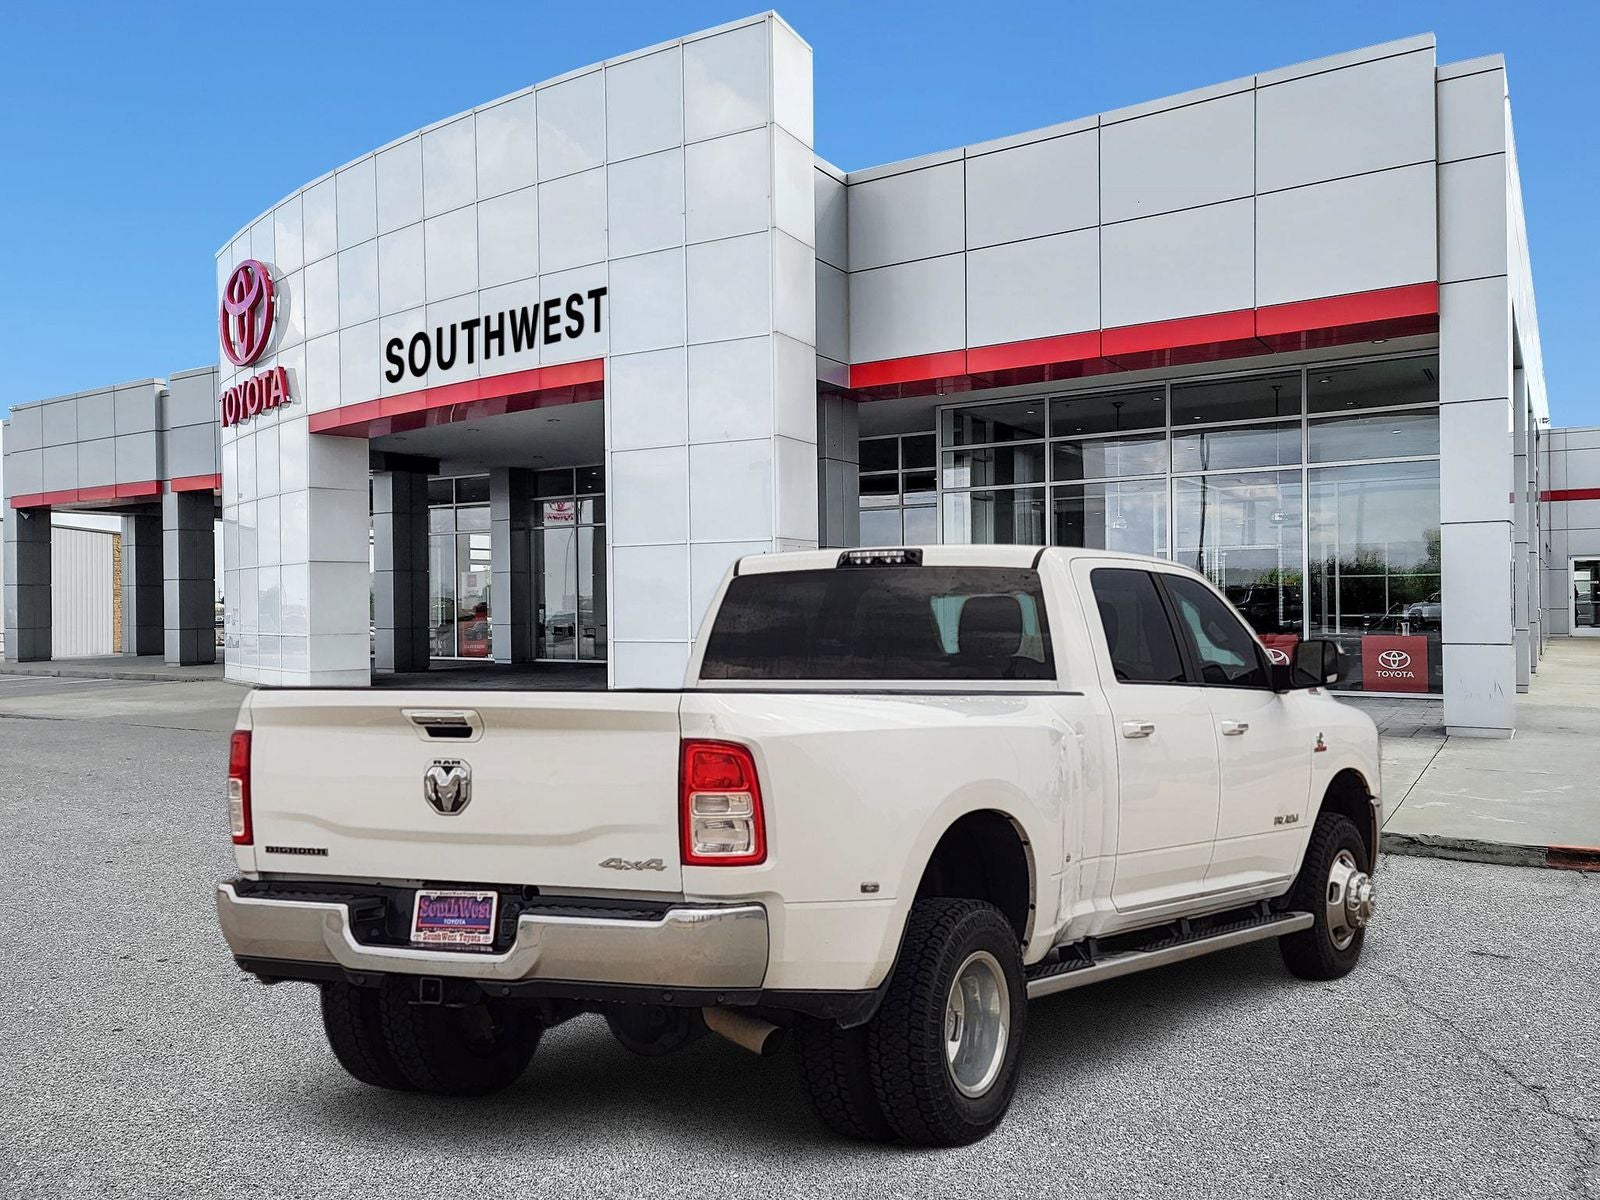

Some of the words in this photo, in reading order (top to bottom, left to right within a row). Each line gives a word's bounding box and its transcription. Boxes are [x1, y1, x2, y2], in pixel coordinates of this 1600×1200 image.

[385, 287, 607, 383] SOUTHWEST
[219, 366, 290, 428] TOYOTA
[459, 932, 481, 943] Toyota
